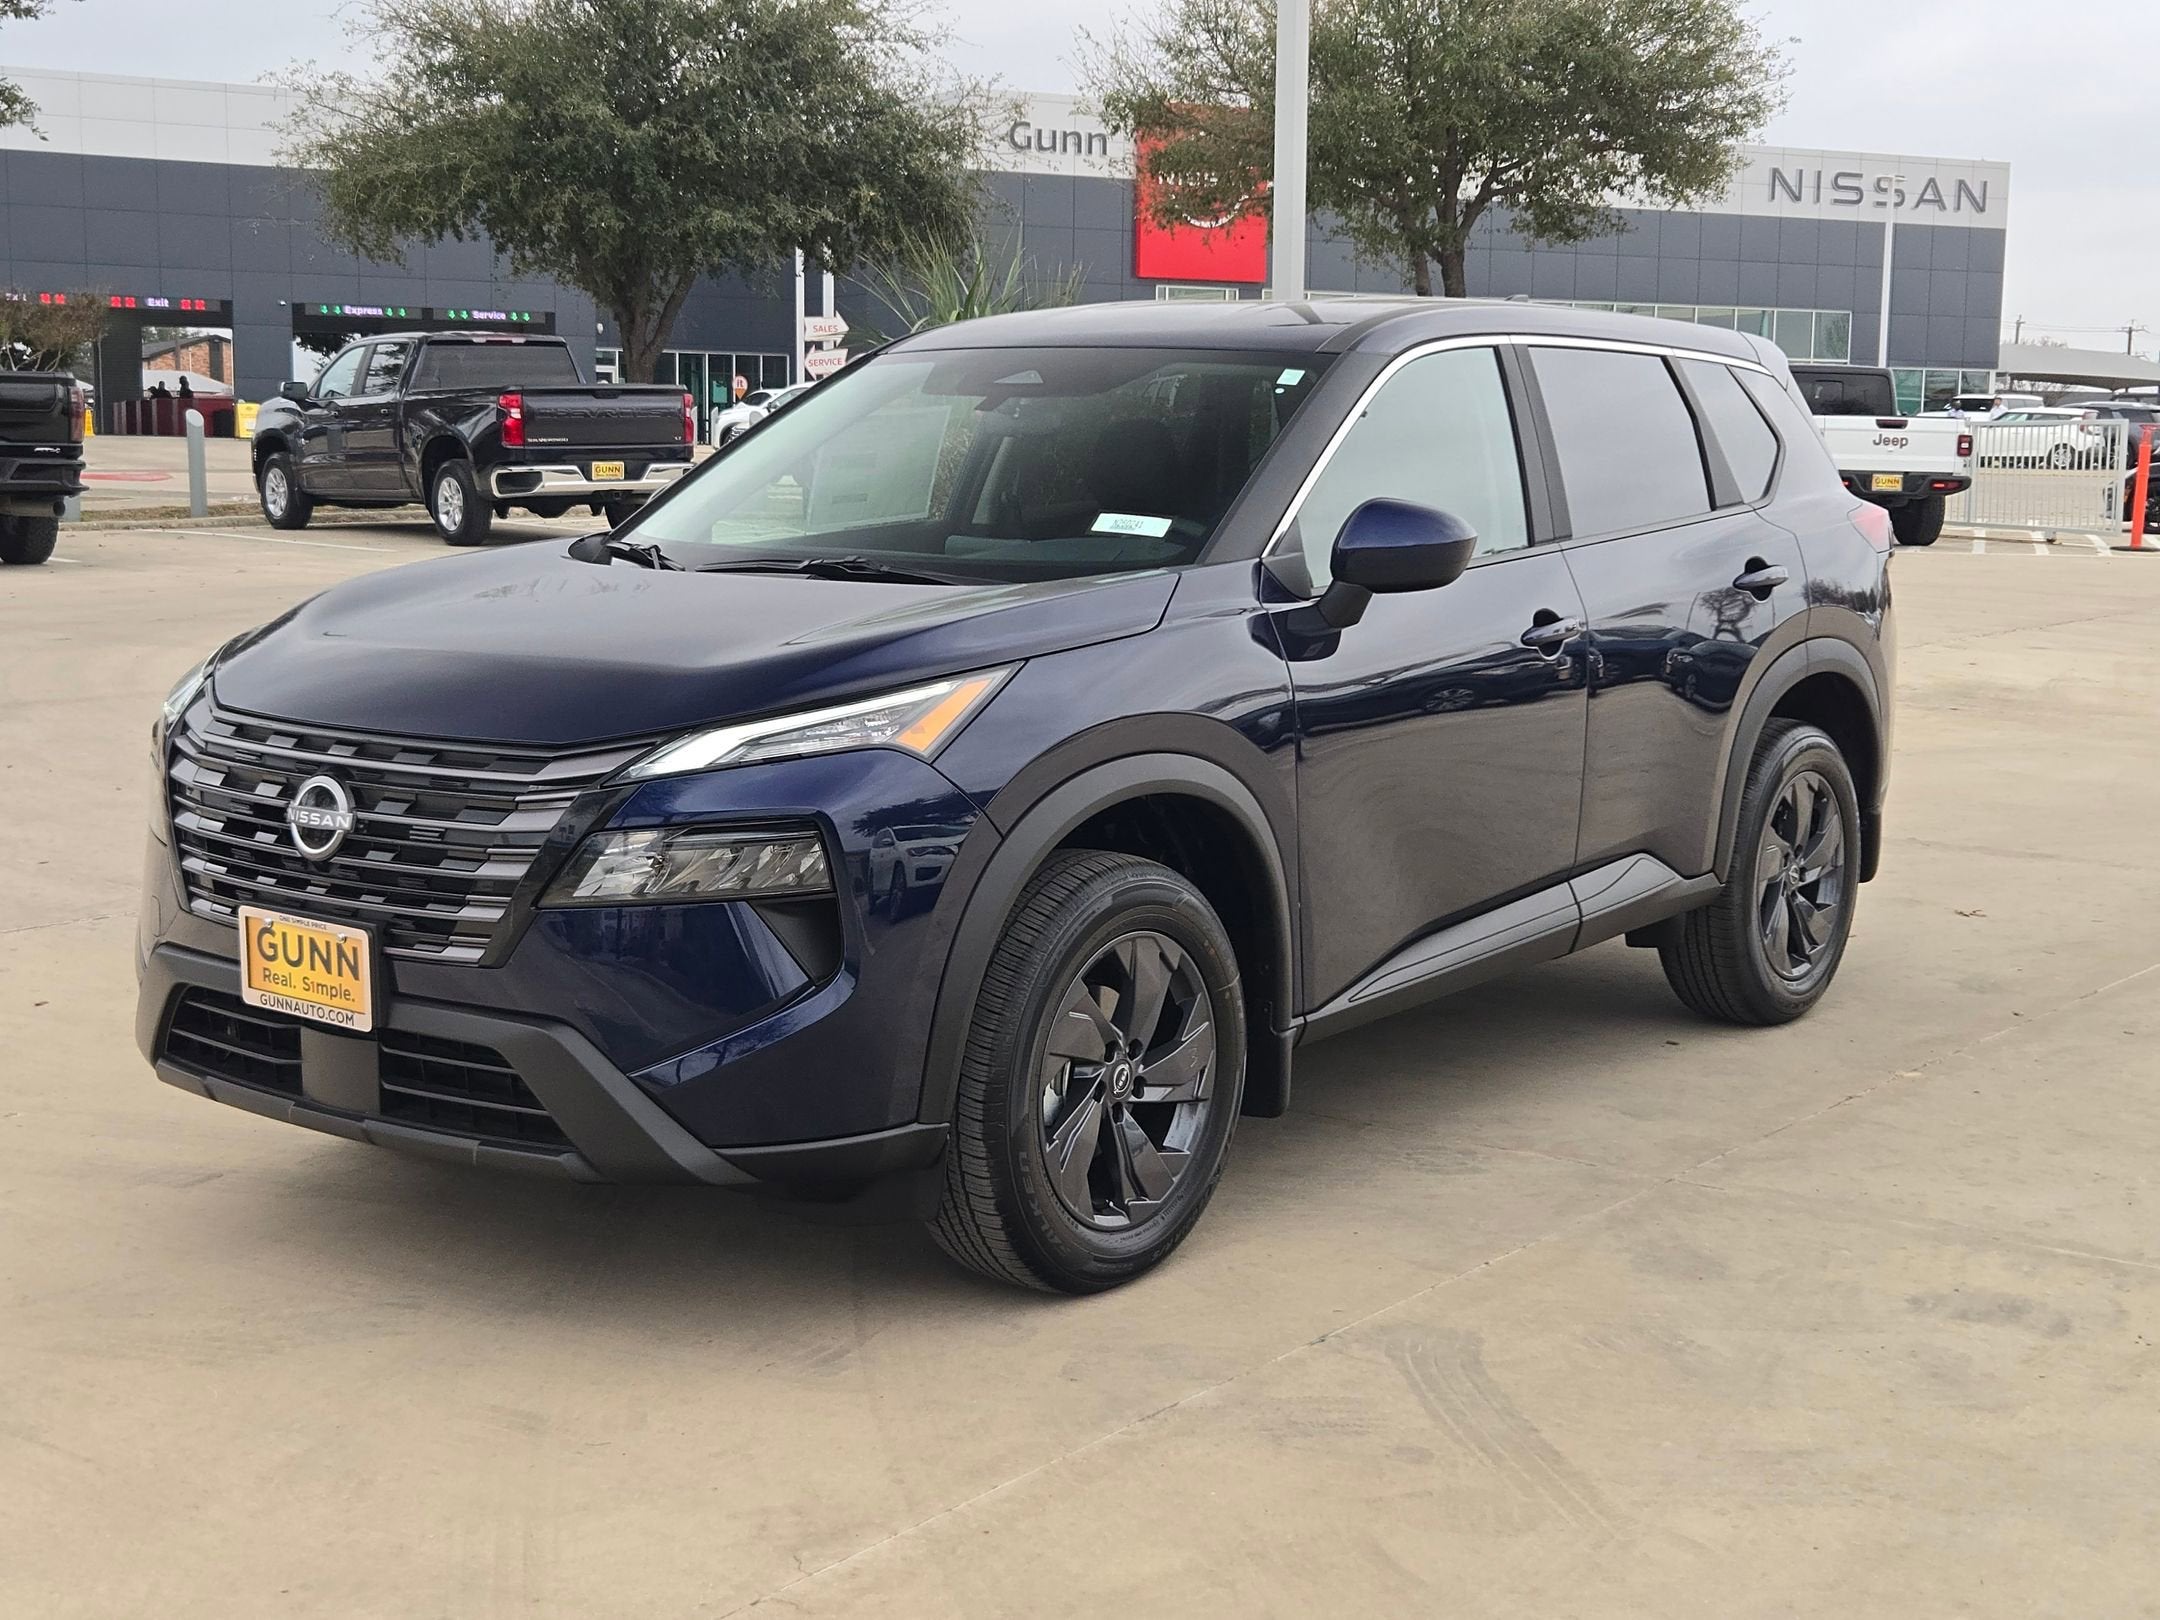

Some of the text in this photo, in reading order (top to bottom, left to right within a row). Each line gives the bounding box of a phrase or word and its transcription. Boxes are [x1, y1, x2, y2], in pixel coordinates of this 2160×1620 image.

[1009, 120, 1108, 156] Gunn
[1768, 166, 1989, 214] NISSAN
[148, 297, 170, 308] Exit
[343, 304, 383, 316] Express
[472, 310, 507, 320] Service
[812, 324, 839, 333] SALES
[808, 357, 842, 368] SERVICE
[1872, 433, 1909, 449] Jeep
[595, 466, 621, 474] GUNN
[1874, 477, 1900, 485] GUNN
[286, 806, 351, 829] NISSAN
[257, 925, 361, 982] GUNN
[263, 967, 296, 990] Real.
[259, 993, 355, 1027] GUNNAUTO.COM
